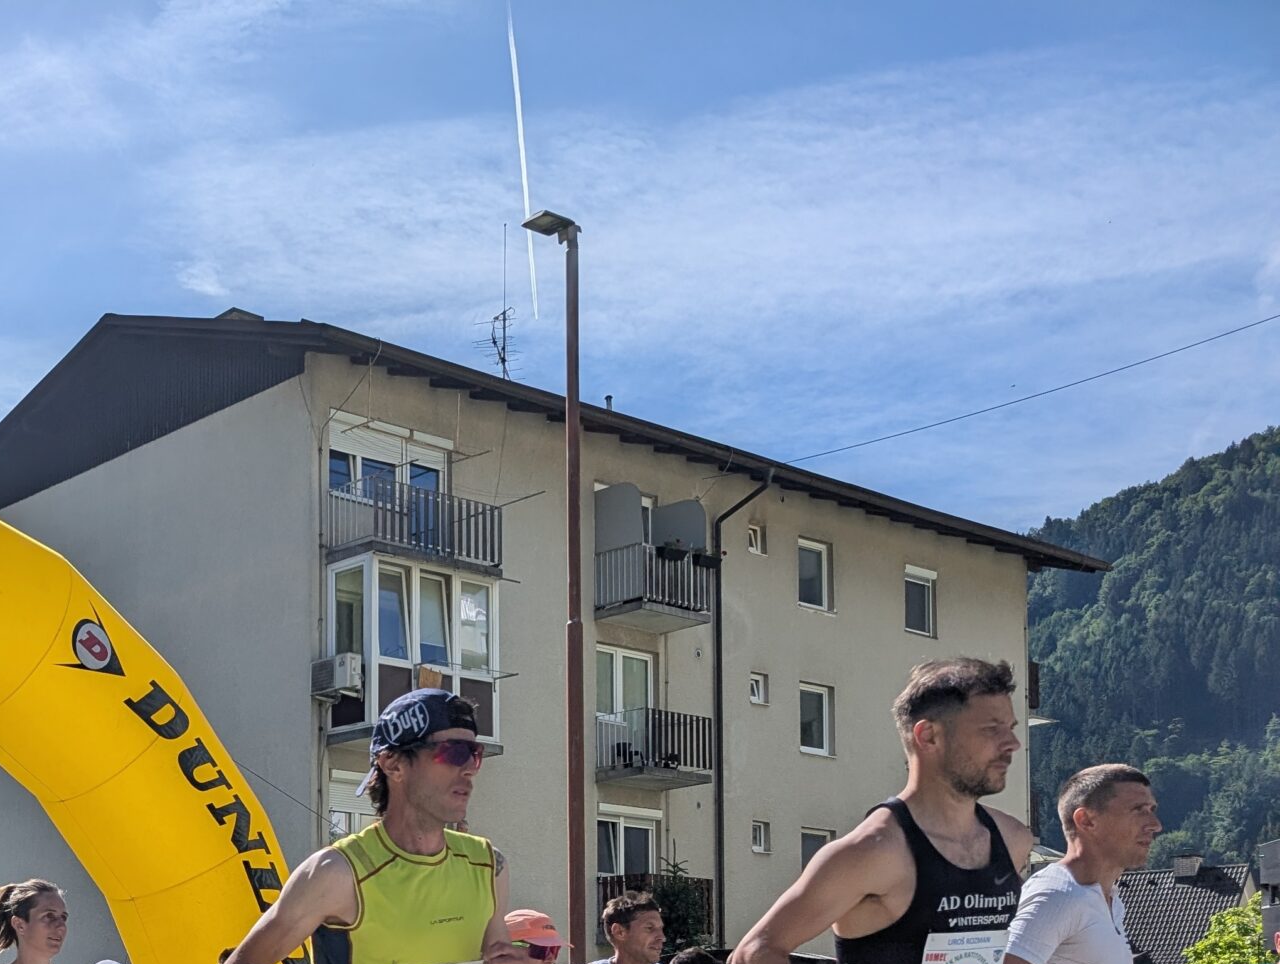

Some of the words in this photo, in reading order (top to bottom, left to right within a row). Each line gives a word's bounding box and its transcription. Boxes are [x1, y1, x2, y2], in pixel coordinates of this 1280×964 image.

[78, 630, 108, 662] D
[937, 895, 960, 912] AD
[964, 891, 1017, 911] Olimpik
[958, 914, 1010, 927] INTERSPORT
